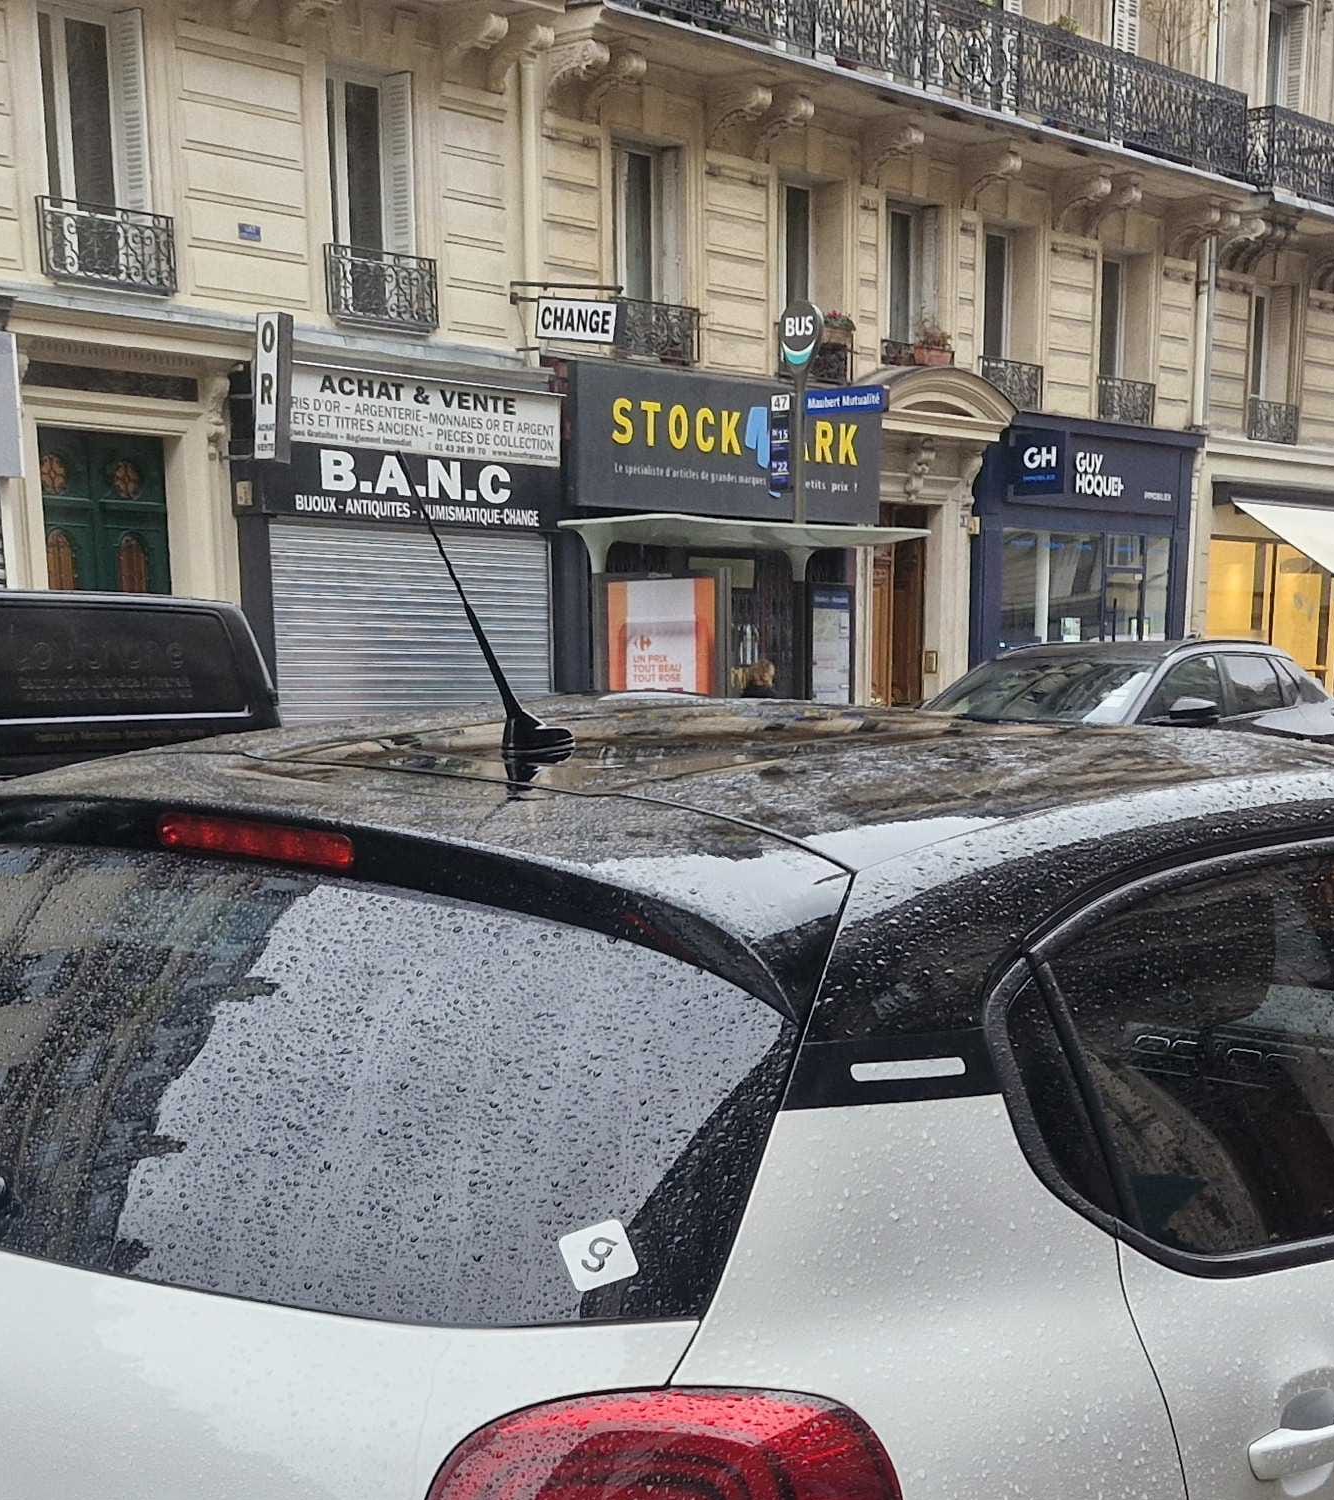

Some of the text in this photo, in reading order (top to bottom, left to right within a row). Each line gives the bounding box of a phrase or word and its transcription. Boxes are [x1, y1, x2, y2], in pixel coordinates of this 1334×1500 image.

[541, 306, 612, 335] CHANGE
[785, 316, 814, 337] BUS
[320, 374, 517, 416] ACHAT & VENTE
[774, 396, 788, 409] 47
[318, 414, 332, 428] ET
[335, 416, 375, 432] TITRES
[378, 421, 425, 438] ANCIENS
[436, 428, 474, 444] PIECES
[476, 433, 491, 446] DE
[493, 434, 555, 451] COLLECTION
[486, 418, 500, 432] OR
[503, 420, 515, 432] ET
[517, 422, 555, 437] ARGENT
[611, 398, 743, 456] STOCK
[1023, 446, 1058, 469] GH
[1075, 452, 1104, 474] GUY
[320, 449, 512, 504] B.A.N.C
[831, 481, 848, 493] prix
[295, 494, 337, 513] BIJOUX
[345, 498, 411, 519] ANTIQUITES
